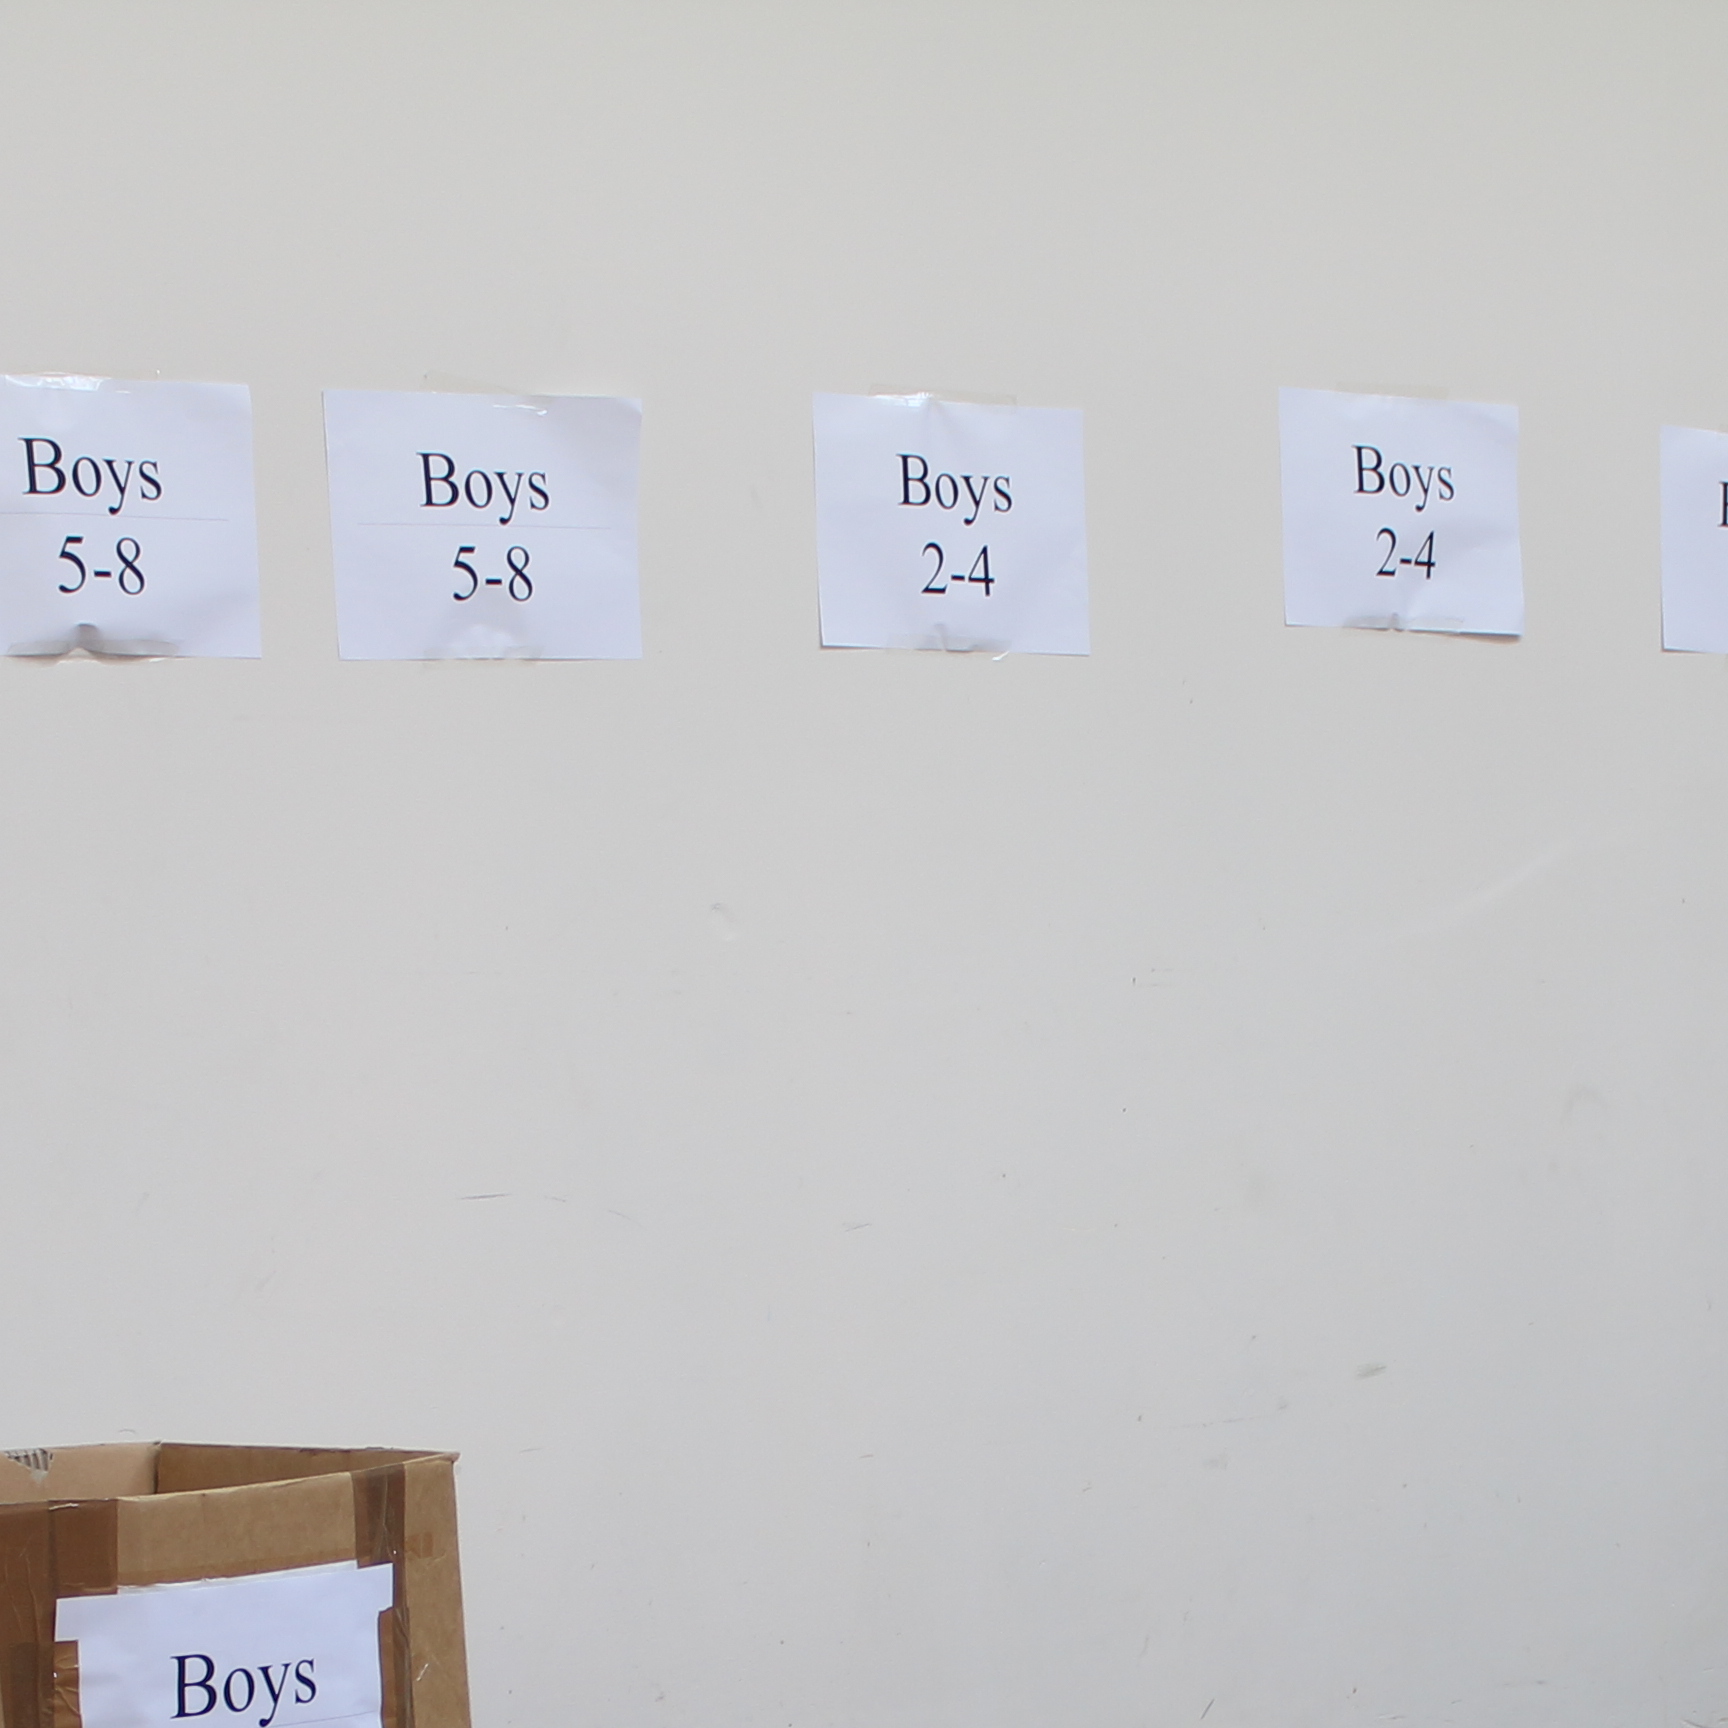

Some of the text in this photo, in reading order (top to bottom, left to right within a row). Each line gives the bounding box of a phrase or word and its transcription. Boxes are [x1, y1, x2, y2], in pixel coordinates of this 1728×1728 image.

[20, 437, 163, 516] Boys
[418, 452, 551, 526] Boys
[899, 453, 1013, 526] Boys
[1353, 445, 1456, 512] Boys
[57, 535, 147, 596] 5-8
[452, 546, 535, 602] 5-8
[921, 542, 996, 597] 2-4
[1376, 527, 1436, 581] 2-4
[171, 1653, 317, 1728] Boys
